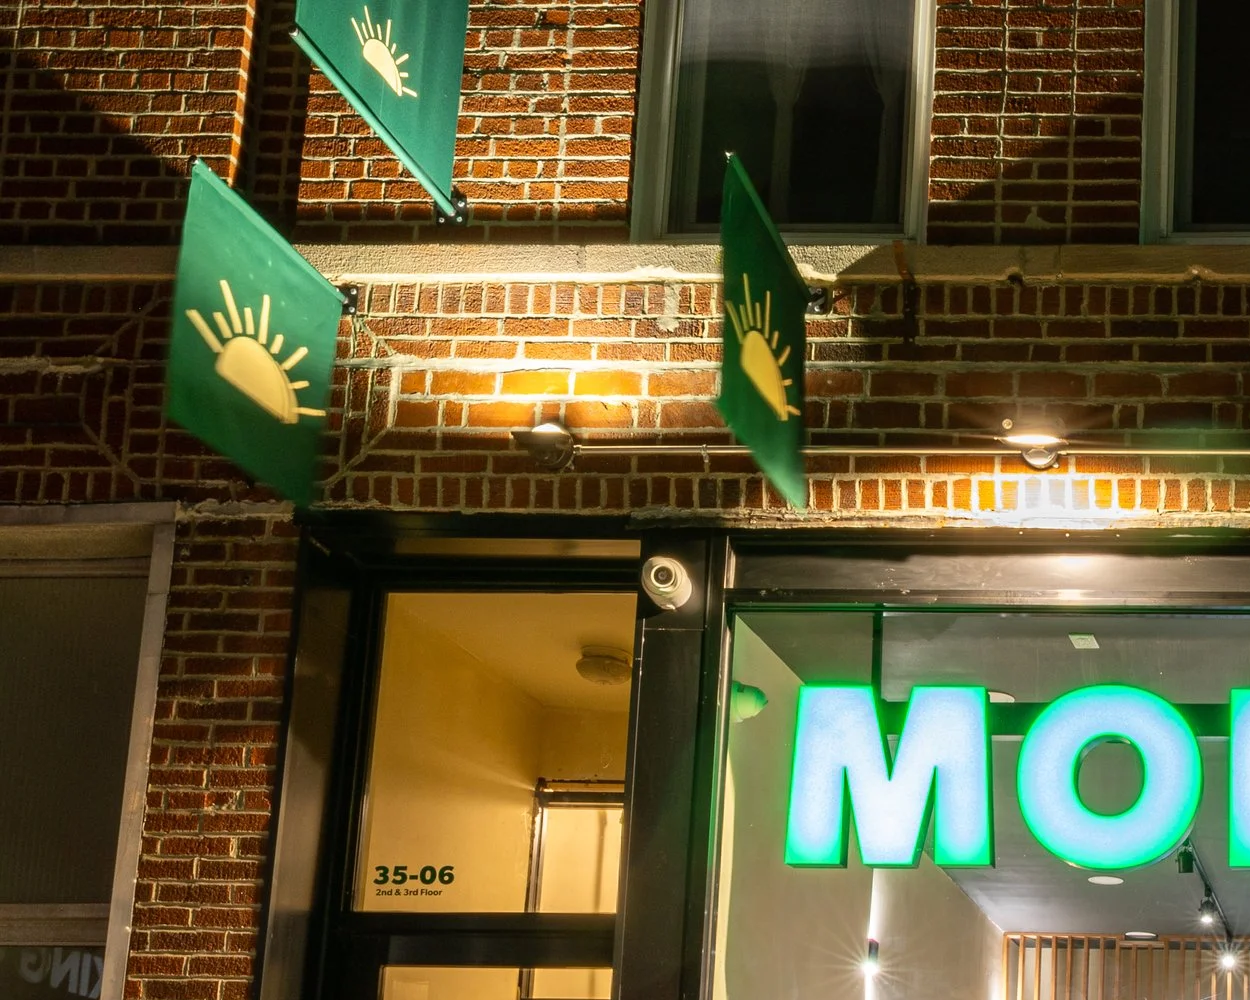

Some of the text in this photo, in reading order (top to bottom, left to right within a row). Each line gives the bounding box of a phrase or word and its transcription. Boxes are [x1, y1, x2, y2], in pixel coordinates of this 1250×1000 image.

[373, 865, 455, 885] 35-06
[376, 888, 443, 896] 2nd & 3rd Floor
